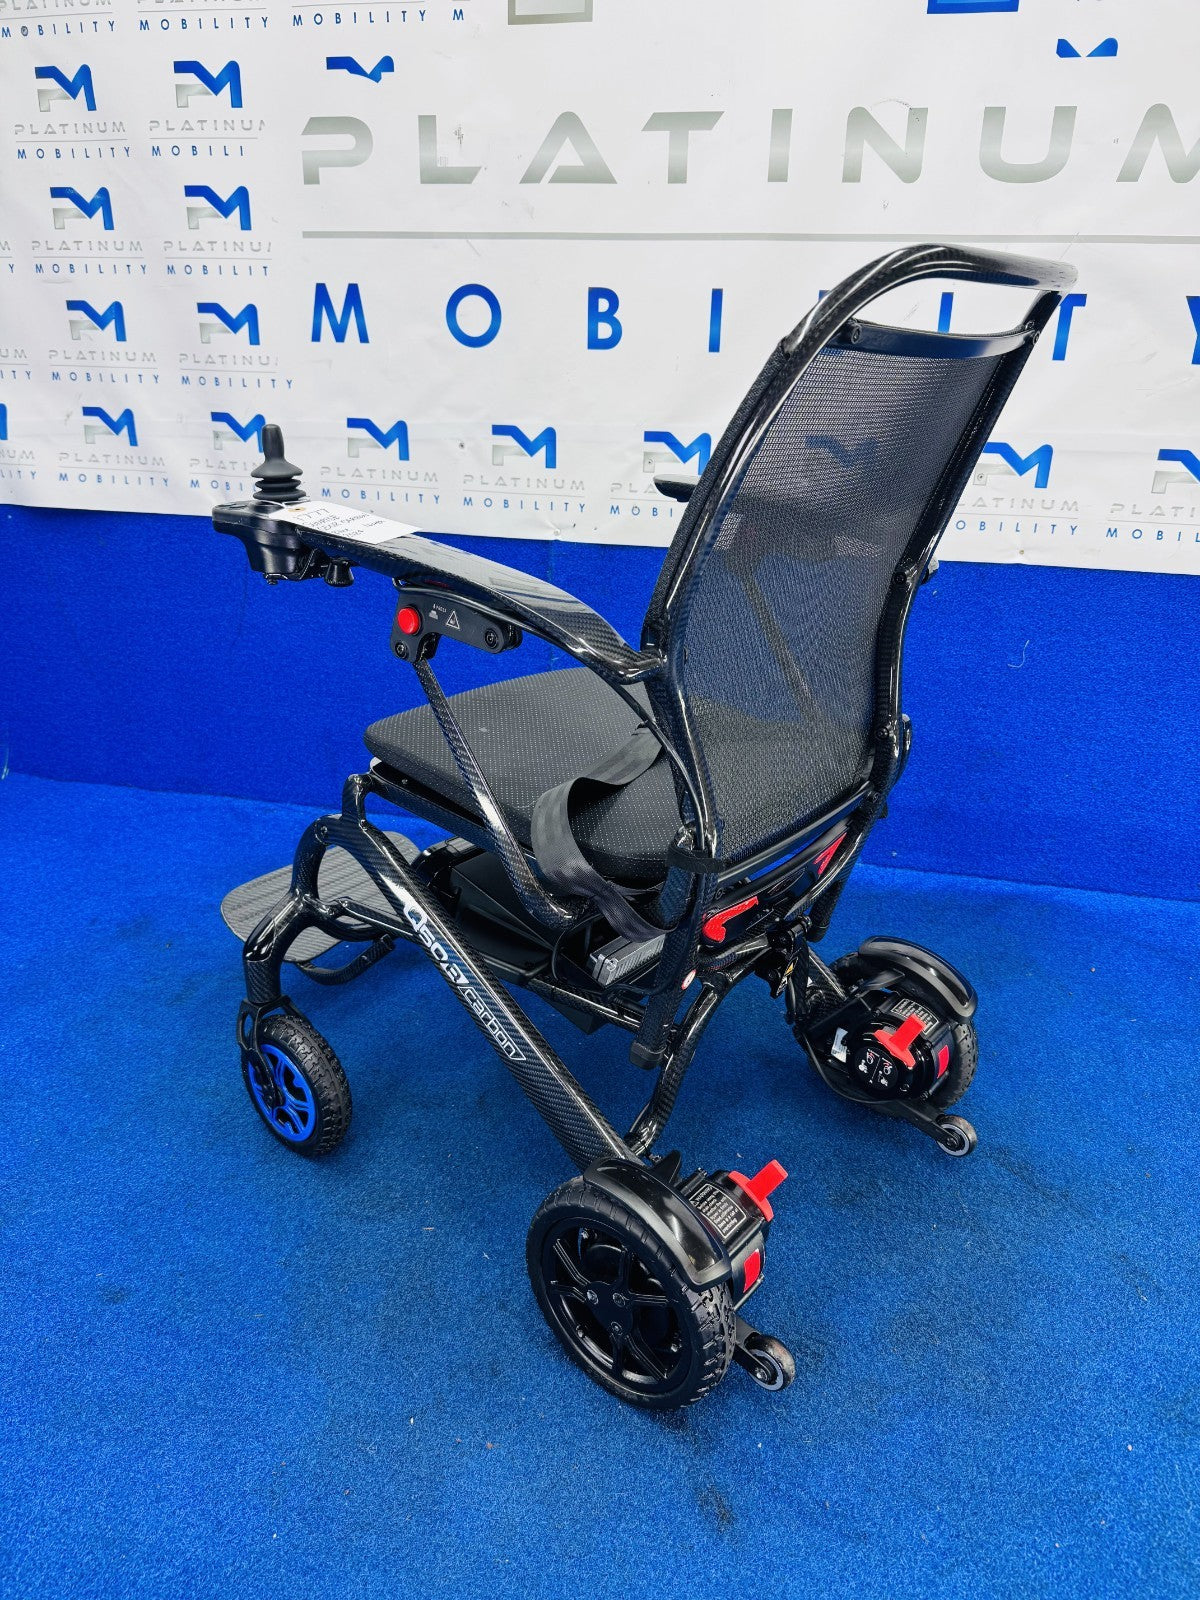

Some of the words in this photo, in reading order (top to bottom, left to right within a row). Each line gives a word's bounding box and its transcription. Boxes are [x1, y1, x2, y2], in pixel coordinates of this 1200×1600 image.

[139, 17, 268, 31] MOBILITY
[292, 9, 426, 26] MOBILITY
[1, 20, 115, 37] MOBILITY
[14, 121, 126, 135] PLATINUM
[301, 103, 1200, 184] PLATINUM
[17, 146, 130, 159] MOBILITY
[151, 145, 244, 157] MOBILI
[32, 240, 143, 252] PLATINUM
[163, 241, 271, 253] PLATINU
[36, 264, 147, 275] MOBILITY
[167, 265, 268, 277] MOBILIT
[49, 350, 156, 363] PLATINUM
[179, 353, 278, 367] PLATINU
[52, 371, 159, 384] MOBILITY
[182, 375, 293, 389] MOBILITY
[59, 451, 166, 467] PLATINUM
[59, 472, 169, 487] MOBILITY
[320, 466, 439, 483] PLATINUM
[463, 474, 585, 491] PLATINUM
[322, 487, 440, 505] MOBILITY
[463, 496, 585, 513] MOBILITY
[958, 496, 1079, 512] ATINUM
[610, 505, 673, 518] MOBI
[956, 520, 1078, 535] OBILITY
[463, 988, 517, 1059] carbon
